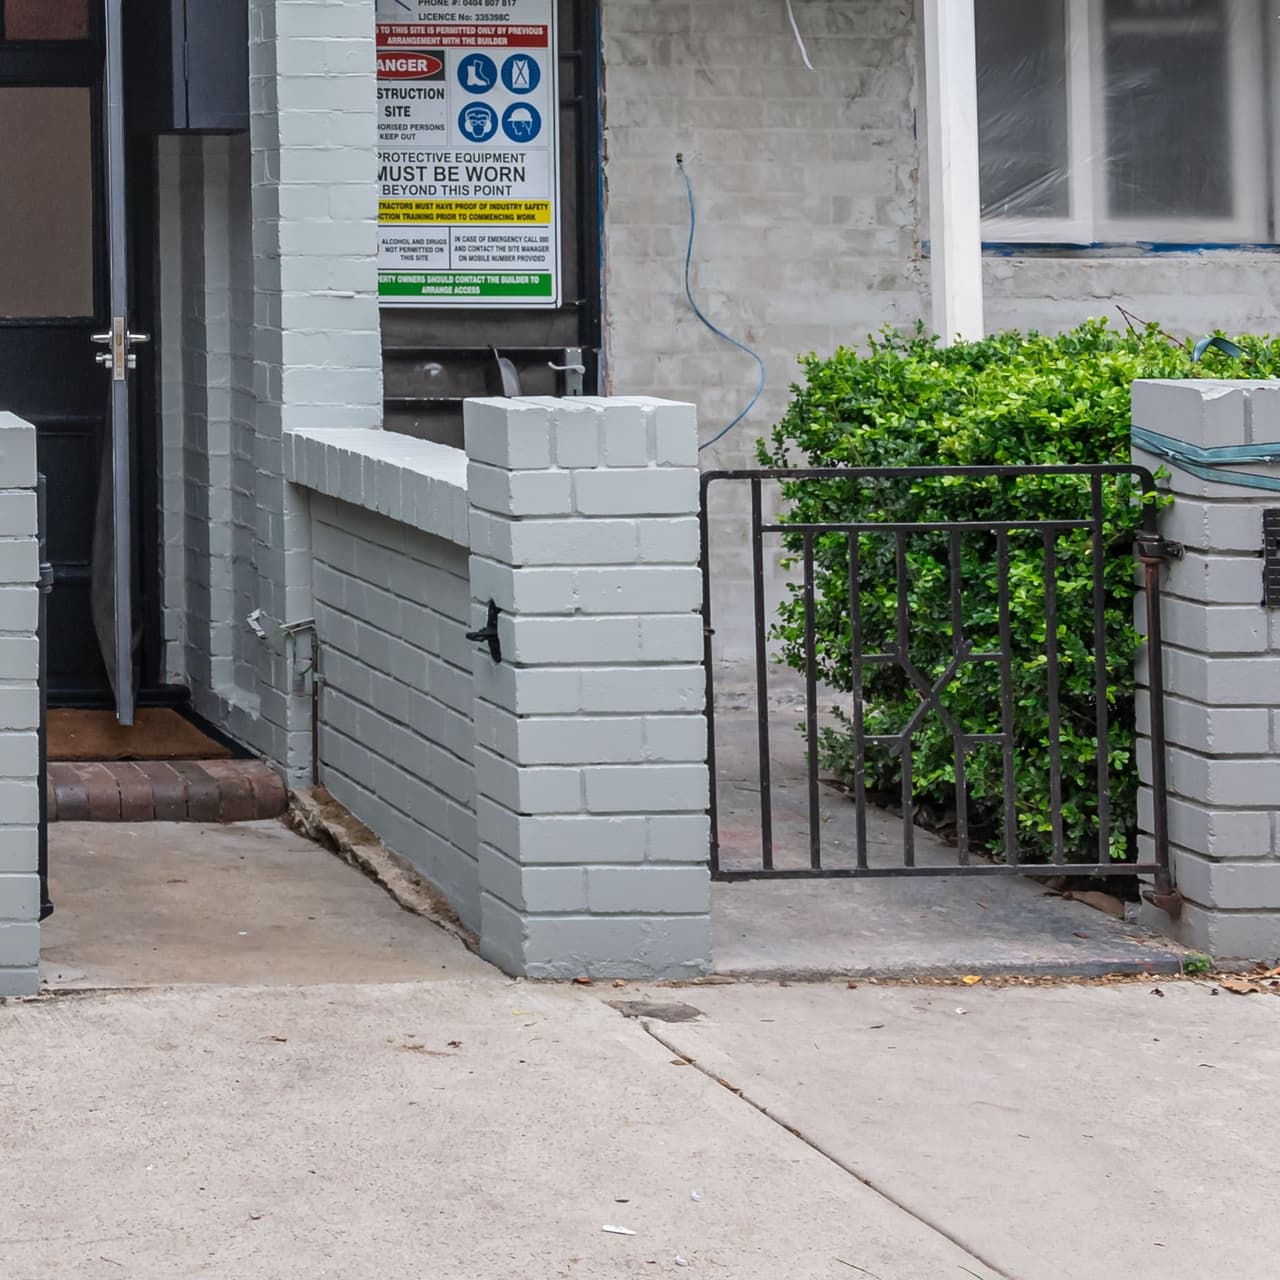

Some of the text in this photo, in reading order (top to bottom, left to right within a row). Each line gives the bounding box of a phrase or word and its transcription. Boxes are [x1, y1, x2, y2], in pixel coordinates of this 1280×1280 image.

[418, 0, 449, 7] PHONE
[452, 0, 460, 7] #:
[462, 0, 482, 7] 0404
[418, 13, 456, 21] LICENCE
[458, 13, 473, 21] No:
[380, 26, 390, 34] TO
[391, 26, 408, 34] THIS
[409, 26, 425, 34] SITE
[427, 26, 435, 34] IS
[435, 26, 476, 34] PERMITTED
[477, 26, 496, 34] ONLY
[497, 26, 507, 34] BY
[508, 26, 544, 34] PREVIOUS
[387, 37, 508, 45] ARRANGEMENT WITH THE BUILDER
[377, 59, 428, 72] ANGER
[377, 88, 445, 100] STRUCTION
[384, 105, 411, 118] SITE
[455, 152, 526, 163] EQUIPMENT
[377, 166, 526, 182] MUST BE WORN
[382, 184, 512, 196] BEYOND THIS POINT
[415, 202, 434, 210] MUST
[435, 202, 453, 210] HAVE
[455, 202, 476, 210] PROOF
[479, 202, 488, 210] OF
[489, 202, 522, 210] INDUSTRY
[524, 202, 549, 210] SAFETY
[397, 276, 425, 284] OWNERS
[427, 276, 454, 284] SHOULD
[455, 276, 484, 284] CONTACT
[485, 276, 499, 284] THE
[501, 276, 529, 284] BUILDER
[530, 276, 539, 284] TO
[421, 286, 480, 294] ARRANGE ACCESS
